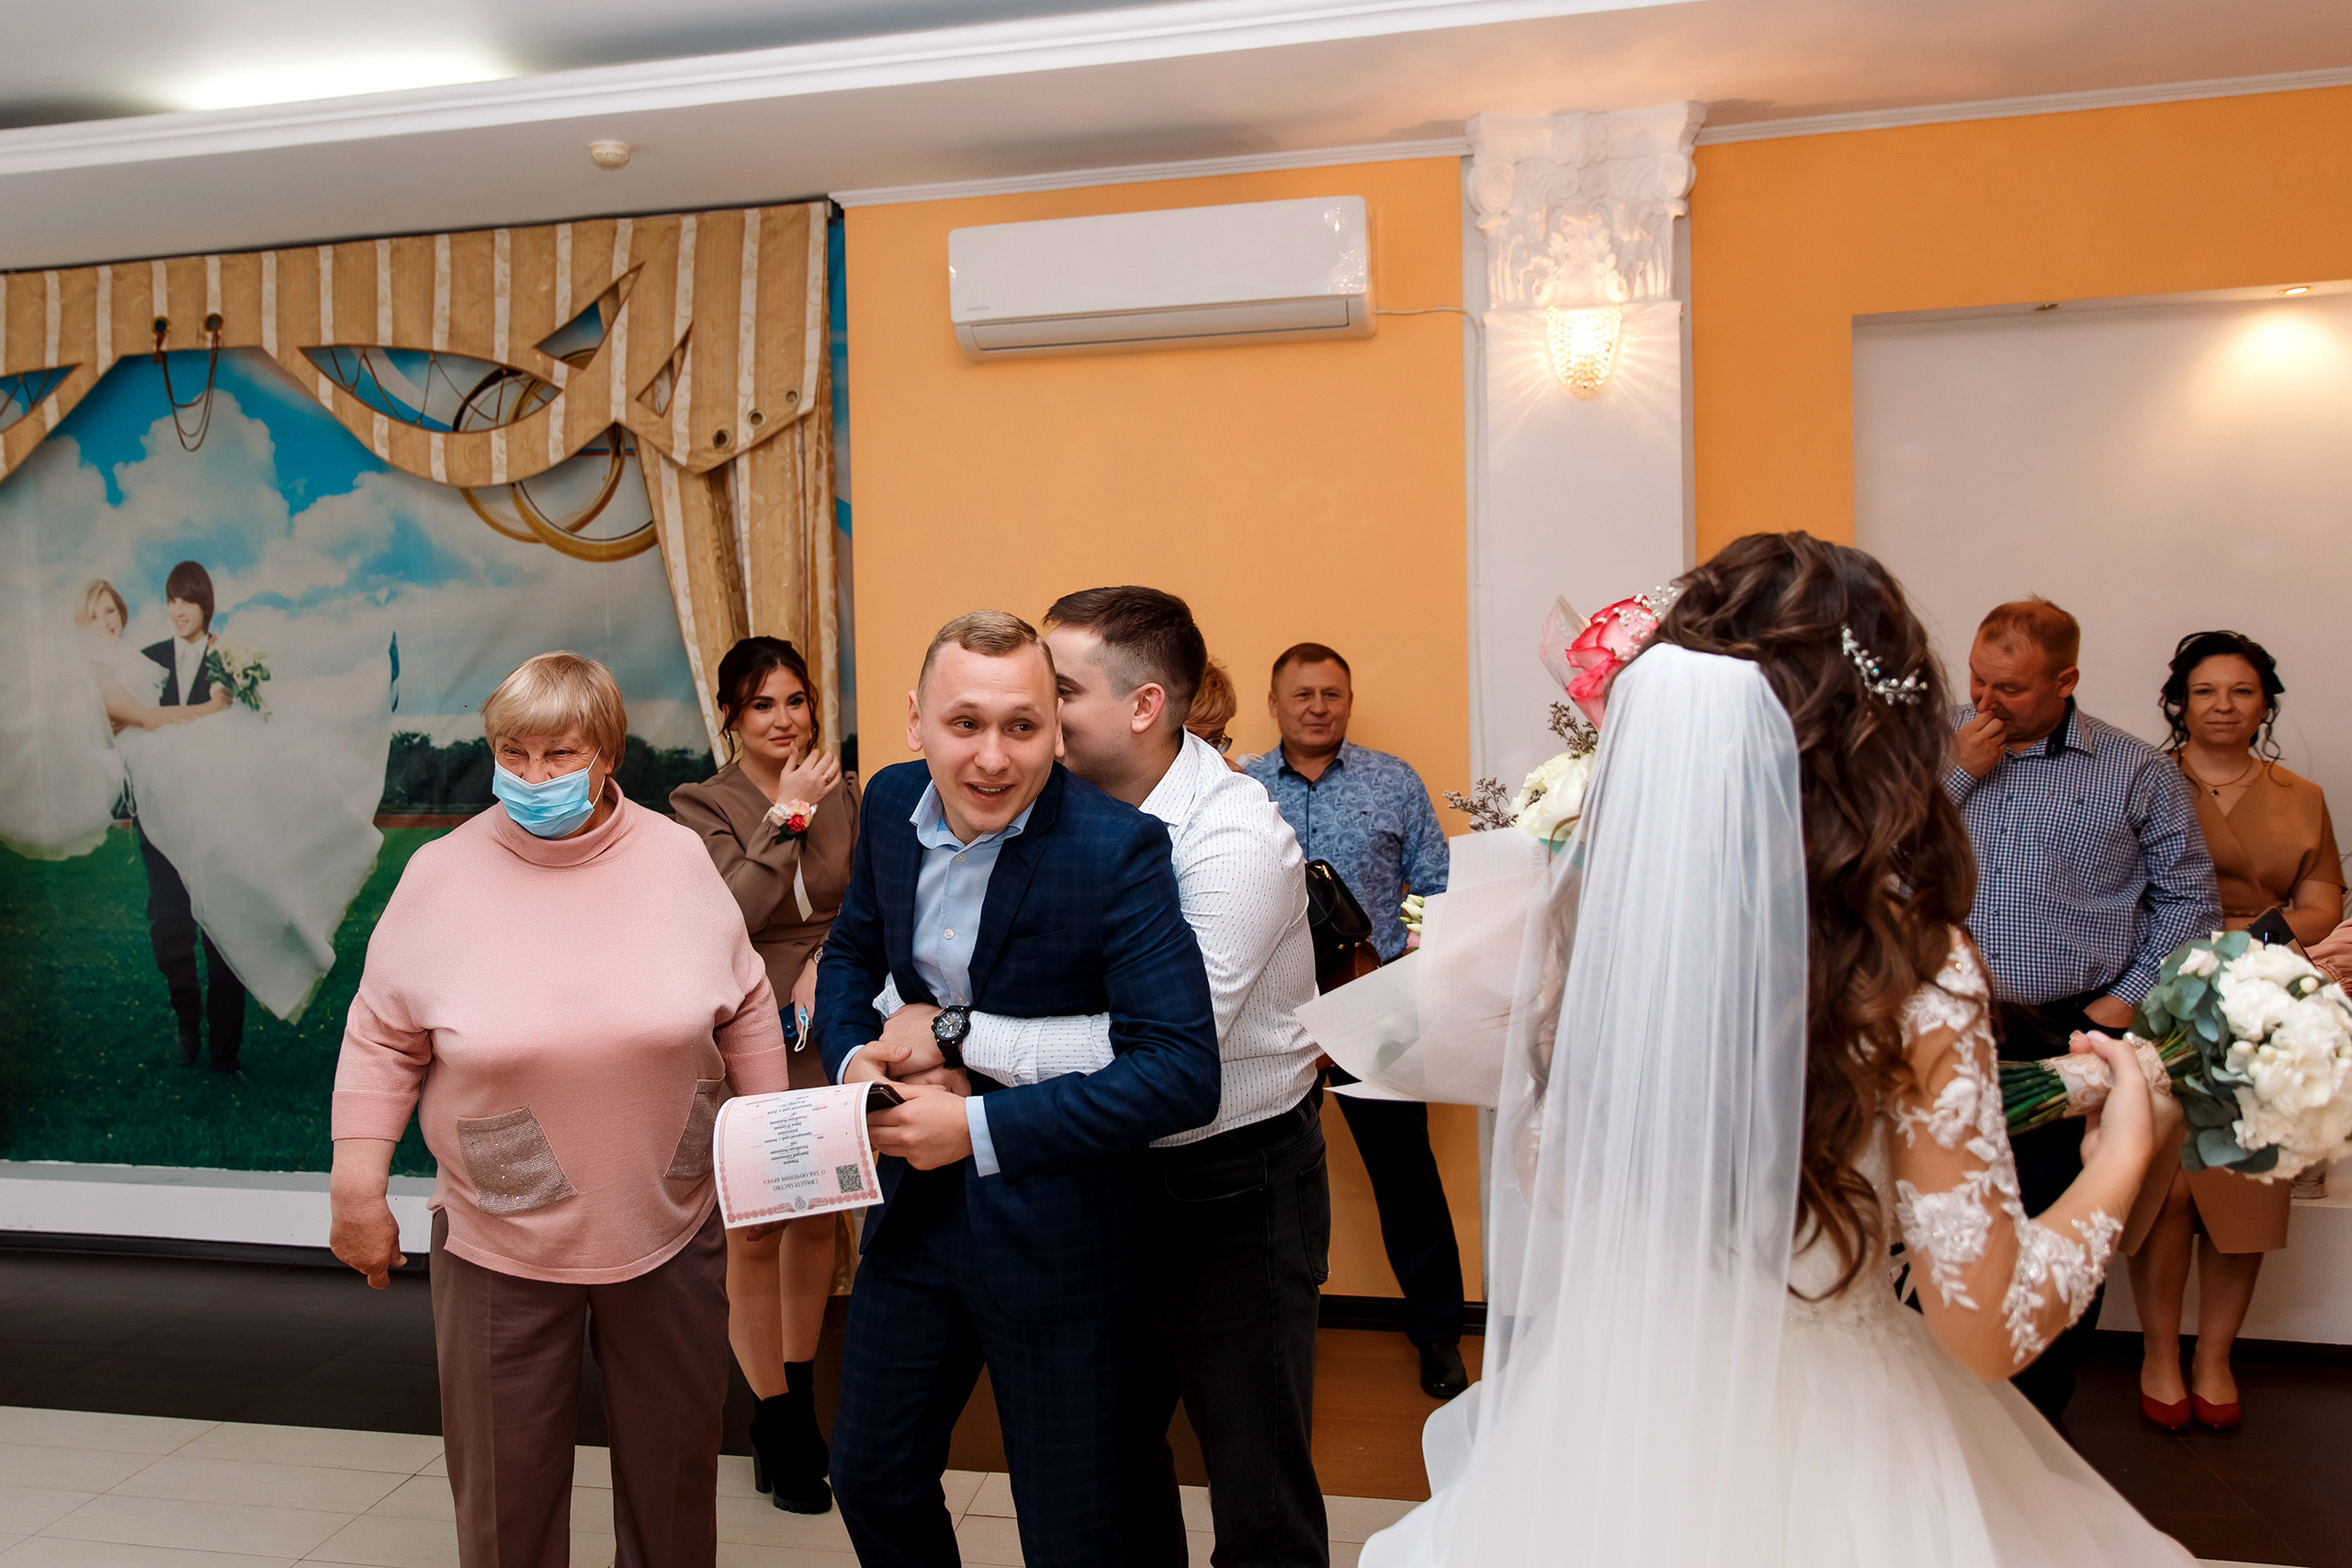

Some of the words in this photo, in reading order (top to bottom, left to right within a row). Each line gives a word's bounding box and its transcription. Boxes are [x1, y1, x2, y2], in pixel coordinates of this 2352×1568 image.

[763, 1177, 780, 1185] БРАКА
[781, 1169, 820, 1181] ЗАКЛЮЧЕНИИ
[773, 1178, 819, 1191] СВИДЕТЕЛЬСТВО
